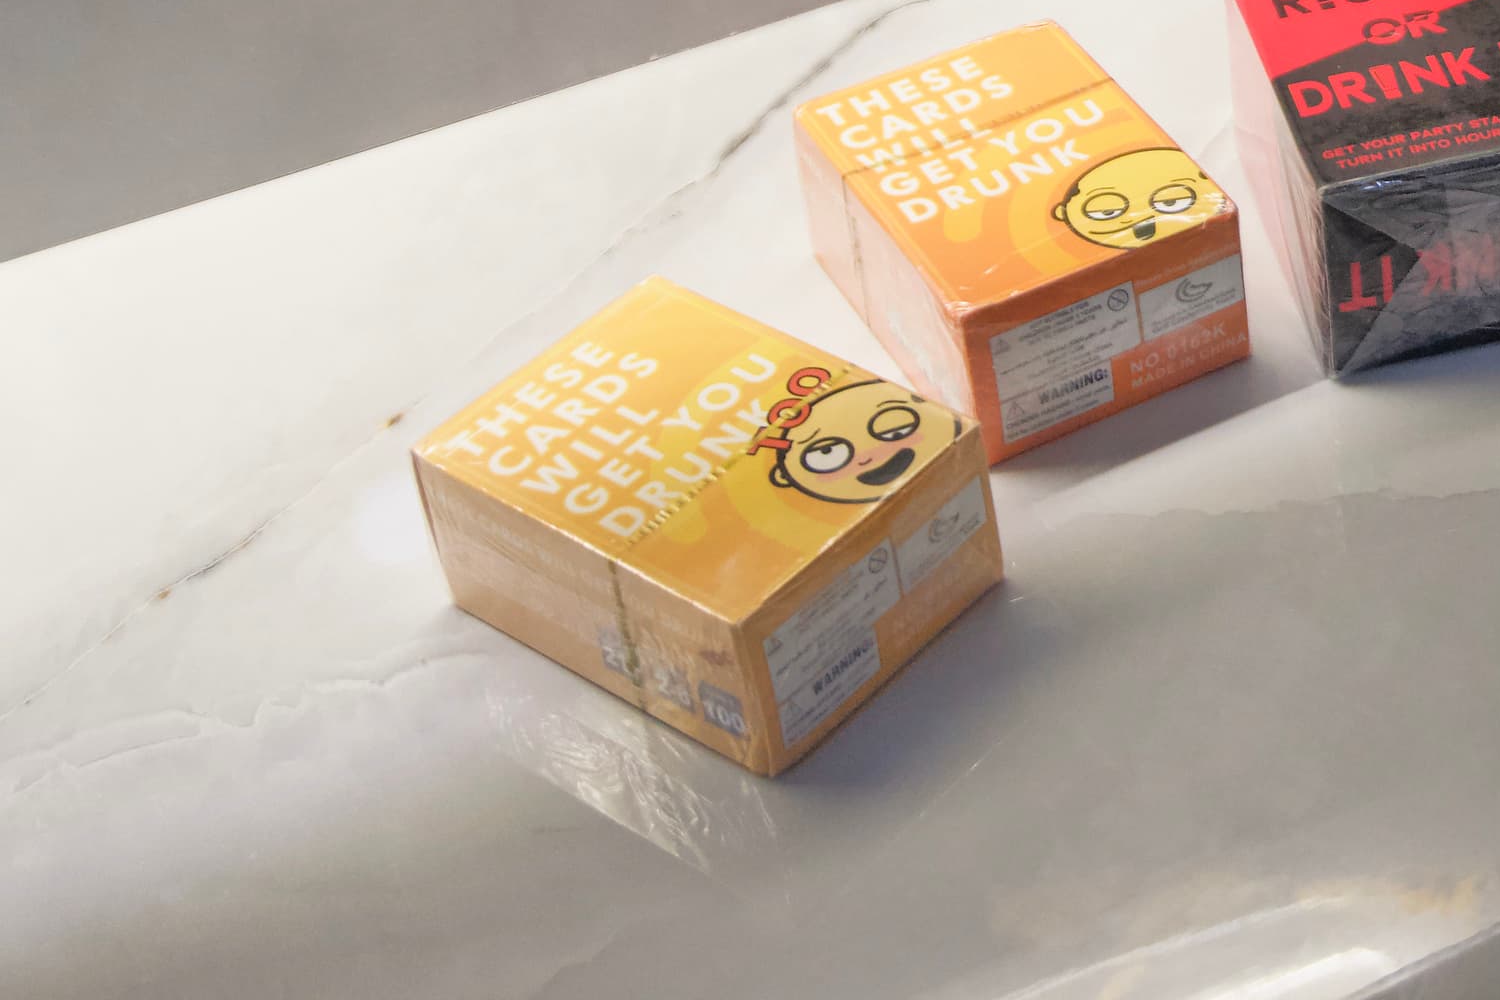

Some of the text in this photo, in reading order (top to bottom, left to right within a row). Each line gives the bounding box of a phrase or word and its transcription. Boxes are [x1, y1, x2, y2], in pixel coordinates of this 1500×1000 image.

[1361, 10, 1447, 44] OR
[816, 55, 984, 127] THESE
[839, 74, 1014, 150] CARDS
[855, 117, 994, 174] WILL
[880, 99, 1106, 197] GET YOU
[898, 138, 1091, 225] DRUNK
[1322, 145, 1355, 161] GET
[1360, 134, 1407, 151] YOUR
[1410, 122, 1465, 141] PARTY
[1336, 152, 1384, 169] TURN
[1387, 147, 1403, 159] IT
[1408, 138, 1452, 155] INTO
[1338, 255, 1394, 313] IT
[1180, 354, 1196, 370] IN
[1199, 332, 1247, 360] CHINA
[447, 340, 616, 458] THESE
[487, 352, 660, 476] CARDS
[564, 353, 779, 515] GET YOU
[746, 367, 831, 457] TOO
[521, 405, 660, 496] WILL
[600, 393, 770, 538] DRUNK
